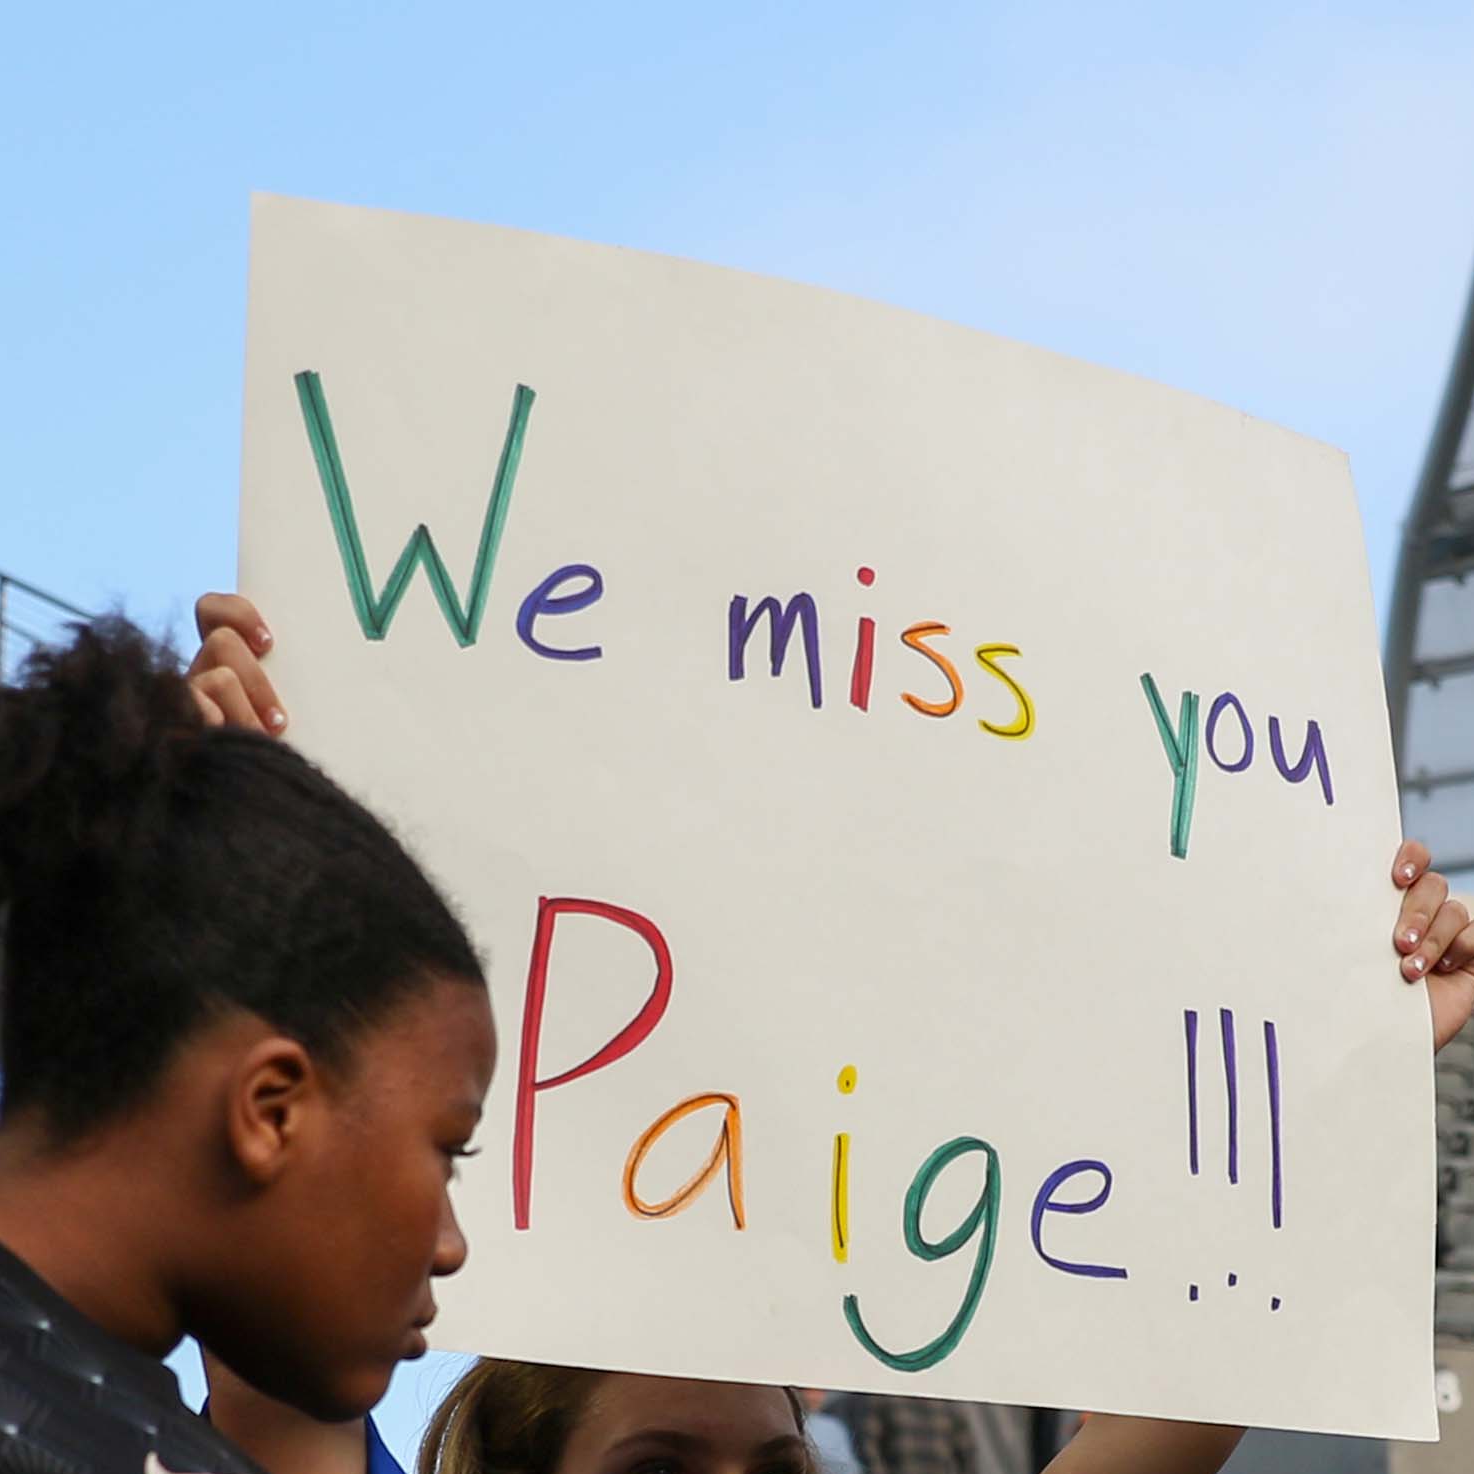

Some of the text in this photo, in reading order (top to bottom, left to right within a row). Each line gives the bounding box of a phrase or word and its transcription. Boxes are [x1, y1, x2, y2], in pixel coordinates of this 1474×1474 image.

[294, 369, 1335, 859] We miss you
[513, 894, 1284, 1373] Paige!!!
